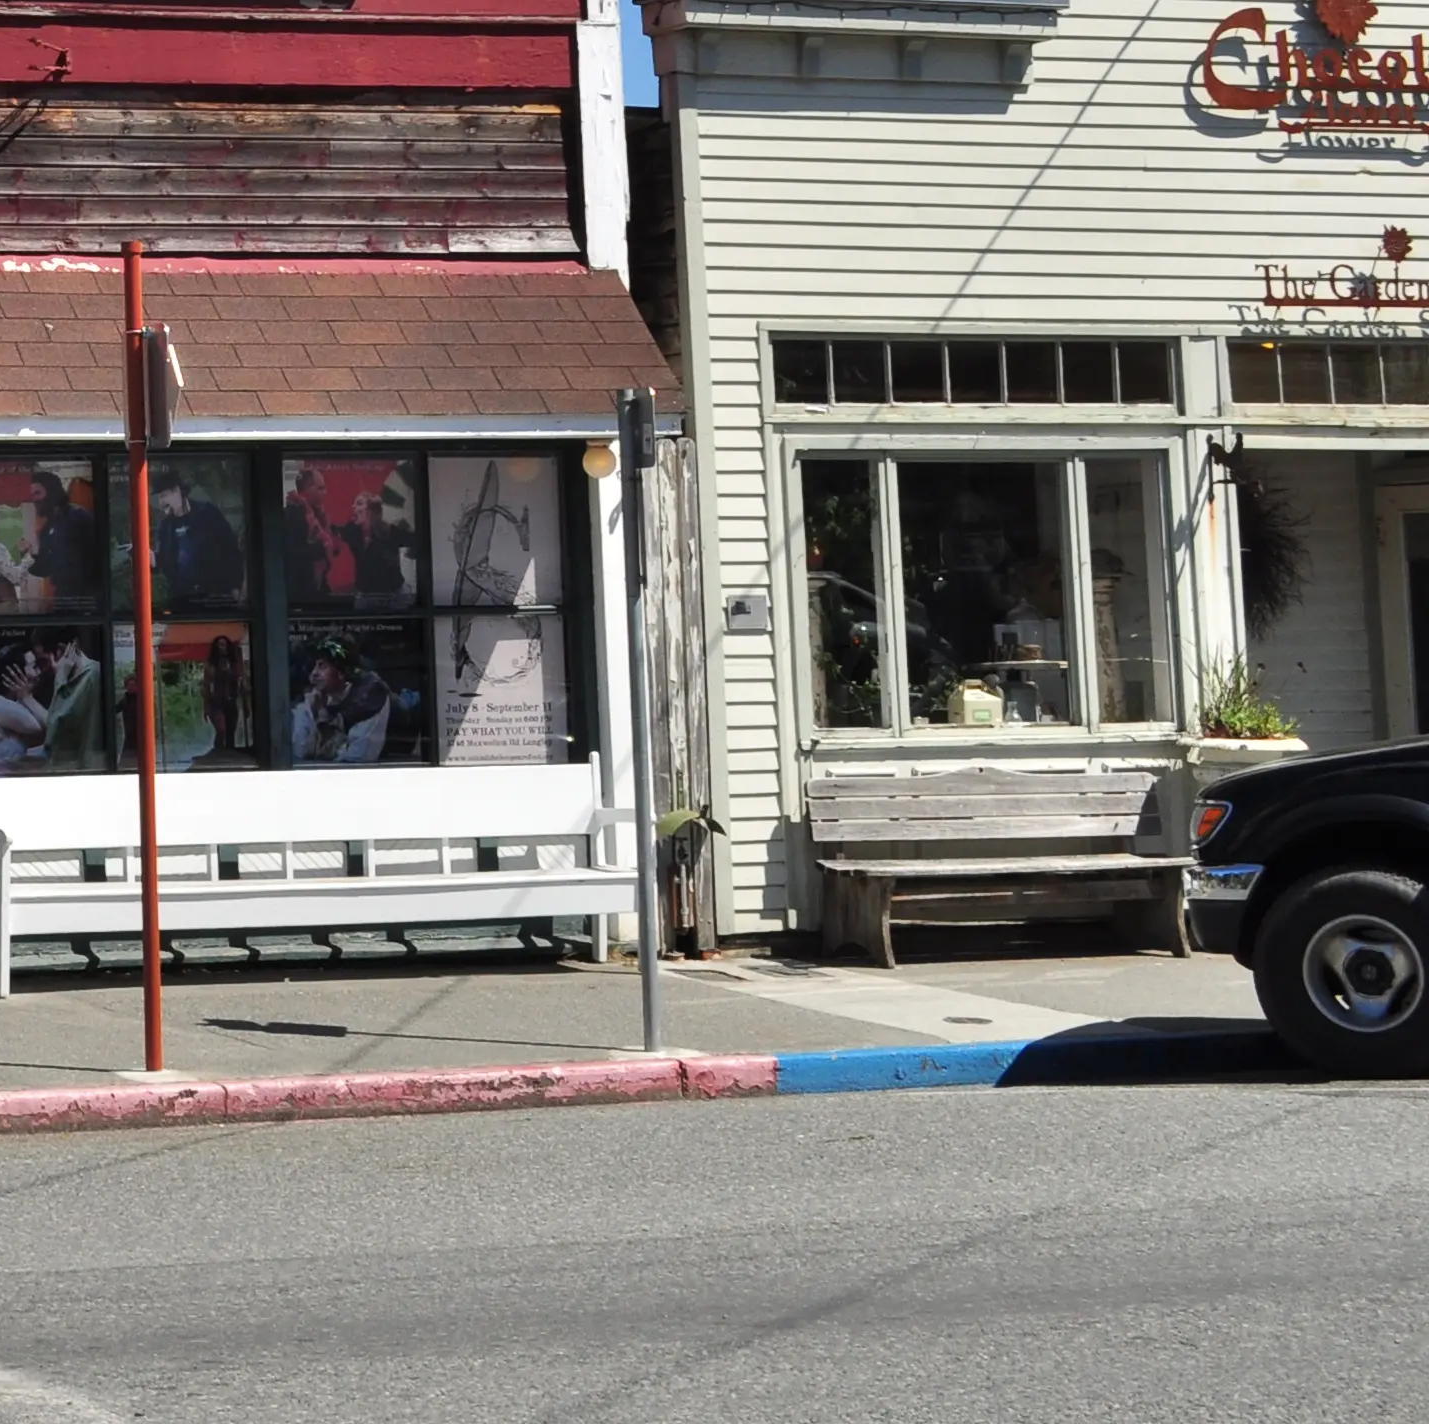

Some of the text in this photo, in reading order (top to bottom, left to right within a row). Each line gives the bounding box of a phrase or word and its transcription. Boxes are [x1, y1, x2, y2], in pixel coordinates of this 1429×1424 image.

[1254, 263, 1315, 300] The
[445, 702, 469, 714] July
[472, 703, 479, 713] 8
[486, 702, 540, 714] September
[446, 725, 553, 737] PAY WHAT YOU WILL
